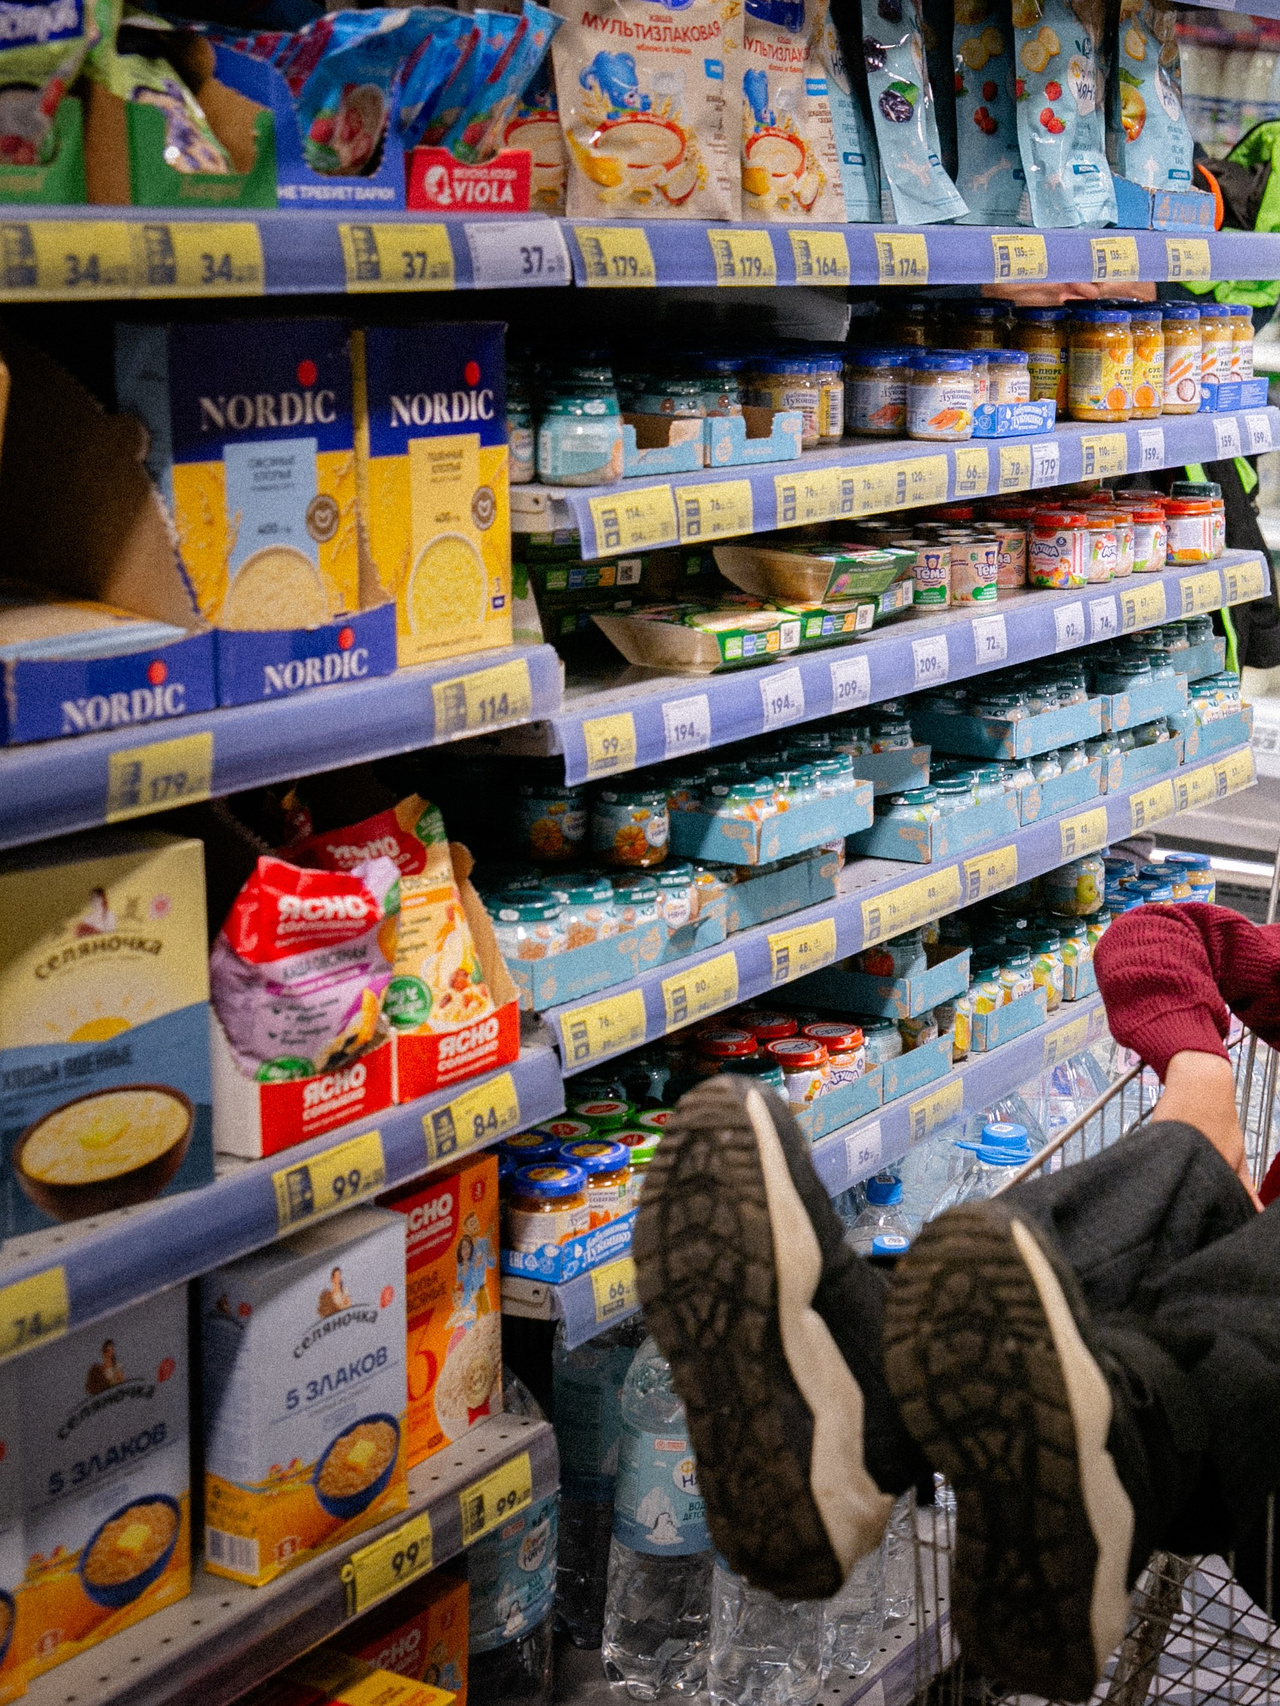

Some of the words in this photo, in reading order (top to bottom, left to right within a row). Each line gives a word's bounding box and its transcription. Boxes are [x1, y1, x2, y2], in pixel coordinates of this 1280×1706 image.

[581, 11, 721, 43] МУЛЬТИЗЛАКОВАЯ
[452, 181, 514, 203] VIOLA
[65, 254, 100, 286] 34
[200, 253, 233, 283] 34
[402, 252, 428, 279] 37
[520, 247, 545, 275] 37
[612, 256, 637, 278] 179
[740, 257, 761, 278] 179
[816, 257, 836, 277] 164
[897, 259, 915, 278] 174
[201, 391, 337, 432] NORDIC
[391, 389, 494, 428] NORDIC
[1221, 435, 1232, 447] 159
[1253, 432, 1264, 443] 159
[1040, 459, 1056, 475] 179
[1144, 449, 1157, 461] 159
[966, 465, 978, 479] 66
[1010, 463, 1020, 476] 78
[913, 566, 946, 580] Тёма
[1066, 624, 1076, 639] 92
[1100, 615, 1110, 630] 74
[986, 636, 997, 651] 72
[264, 648, 368, 694] NORDIC
[919, 656, 937, 673] 209
[839, 680, 857, 699] 209
[61, 683, 186, 734] NORDIC
[479, 692, 509, 722] 114
[771, 694, 790, 715] 194
[674, 721, 696, 742] 194
[602, 736, 619, 755] 99
[149, 771, 187, 800] 179
[278, 895, 368, 921] ЯСНО
[35, 935, 163, 980] селяночка
[438, 1017, 499, 1060] ЯСНО
[302, 1063, 367, 1108] ЯСНО
[474, 1106, 498, 1139] 84
[858, 1148, 869, 1165] 56
[332, 1169, 361, 1201] 99
[407, 1192, 454, 1232] СНО
[609, 1280, 625, 1300] 66
[293, 1309, 379, 1359] селяночка
[286, 1388, 300, 1410] 5
[306, 1346, 388, 1401] ЗЛАКОВ
[48, 1471, 65, 1495] 5
[72, 1422, 167, 1485] ЗЛАКОВ
[496, 1489, 517, 1516] 99
[391, 1541, 419, 1576] 99
